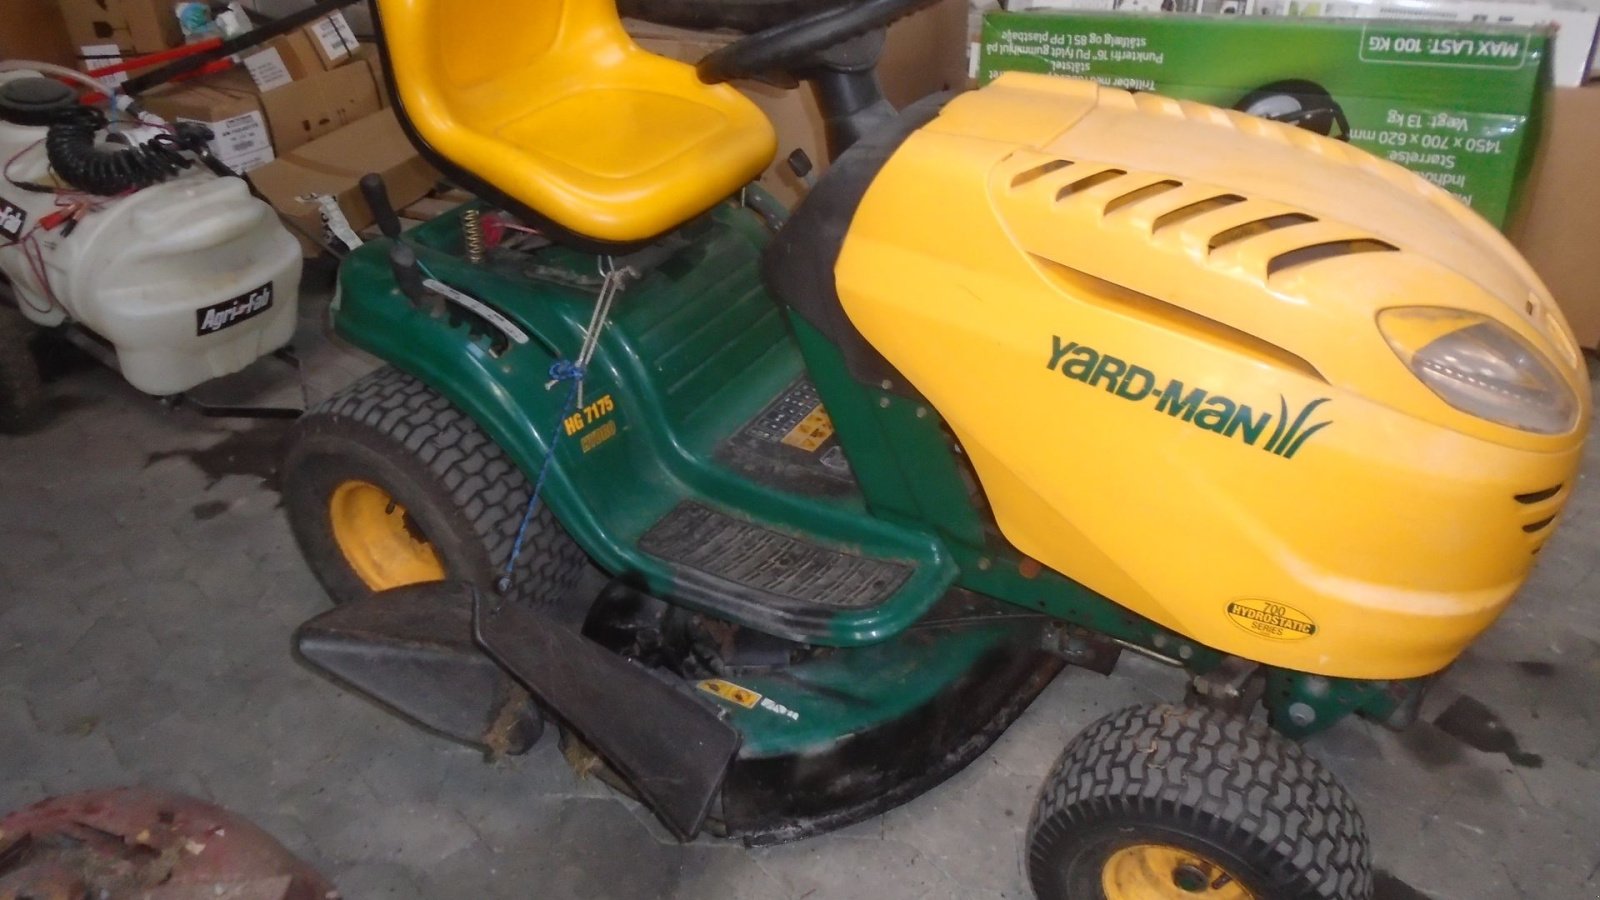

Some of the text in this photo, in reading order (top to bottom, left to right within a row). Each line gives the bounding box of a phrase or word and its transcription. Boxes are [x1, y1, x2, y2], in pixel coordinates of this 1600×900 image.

[1049, 34, 1066, 44] PP
[1074, 34, 1087, 46] 85
[1089, 33, 1102, 44] og
[986, 43, 998, 55] på
[1051, 44, 1074, 57] fyldt
[1075, 47, 1091, 60] PU
[1369, 36, 1519, 58] MAX LAST: 100 KG
[1109, 50, 1164, 64] Punkterfri
[1387, 109, 1404, 124] kg
[1407, 114, 1422, 128] 13
[1350, 128, 1502, 155] 1450 x 700 x 620 mm
[563, 394, 614, 436] HG 7175
[1263, 602, 1286, 616] 700
[1232, 604, 1311, 633] HYDROSTATIC
[1251, 620, 1284, 635] SERIES
